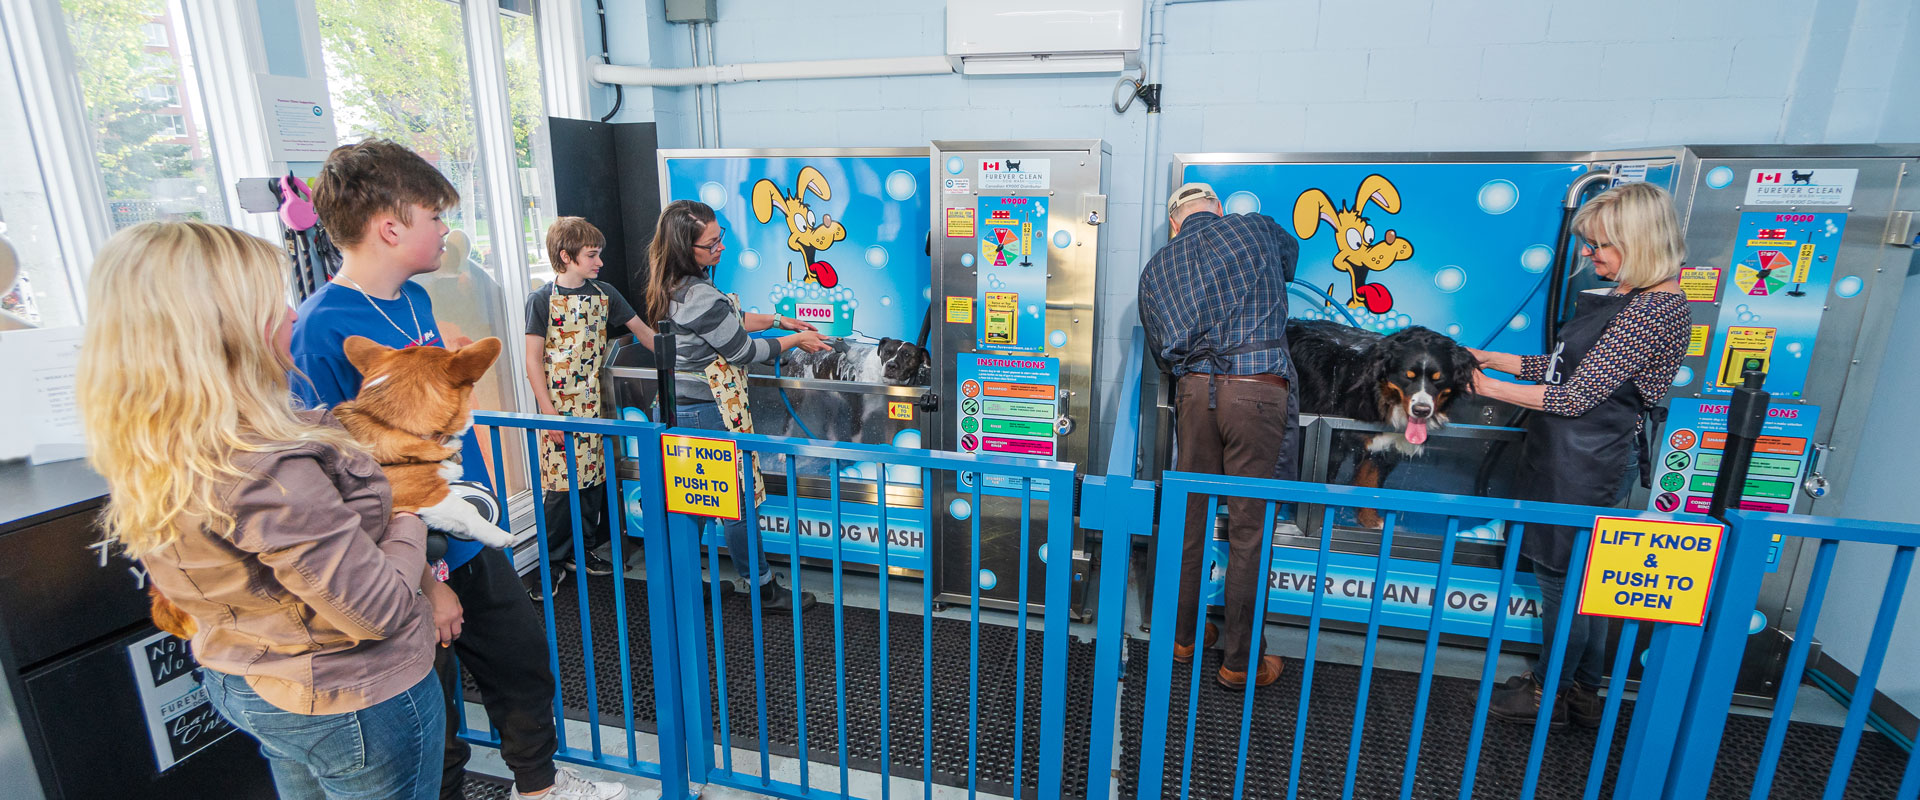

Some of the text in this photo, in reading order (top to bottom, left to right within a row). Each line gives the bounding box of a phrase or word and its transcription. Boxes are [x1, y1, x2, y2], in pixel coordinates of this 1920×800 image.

[1775, 214, 1815, 222] K9000
[798, 308, 831, 317] K9000
[977, 357, 1046, 369] INSTRUCTIONS
[1699, 403, 1799, 419] INSTONS
[666, 444, 732, 462] LIFT KNOB
[696, 463, 705, 475] &
[674, 476, 729, 493] PUSH TO
[685, 493, 720, 507] OPEN
[1600, 529, 1712, 552] LIFT KNOB
[1643, 553, 1658, 568] &
[1601, 570, 1694, 591] PUSH TO
[1614, 591, 1673, 610] OPEN
[153, 638, 177, 660] No
[158, 654, 184, 681] No
[161, 688, 206, 717] FUREVE
